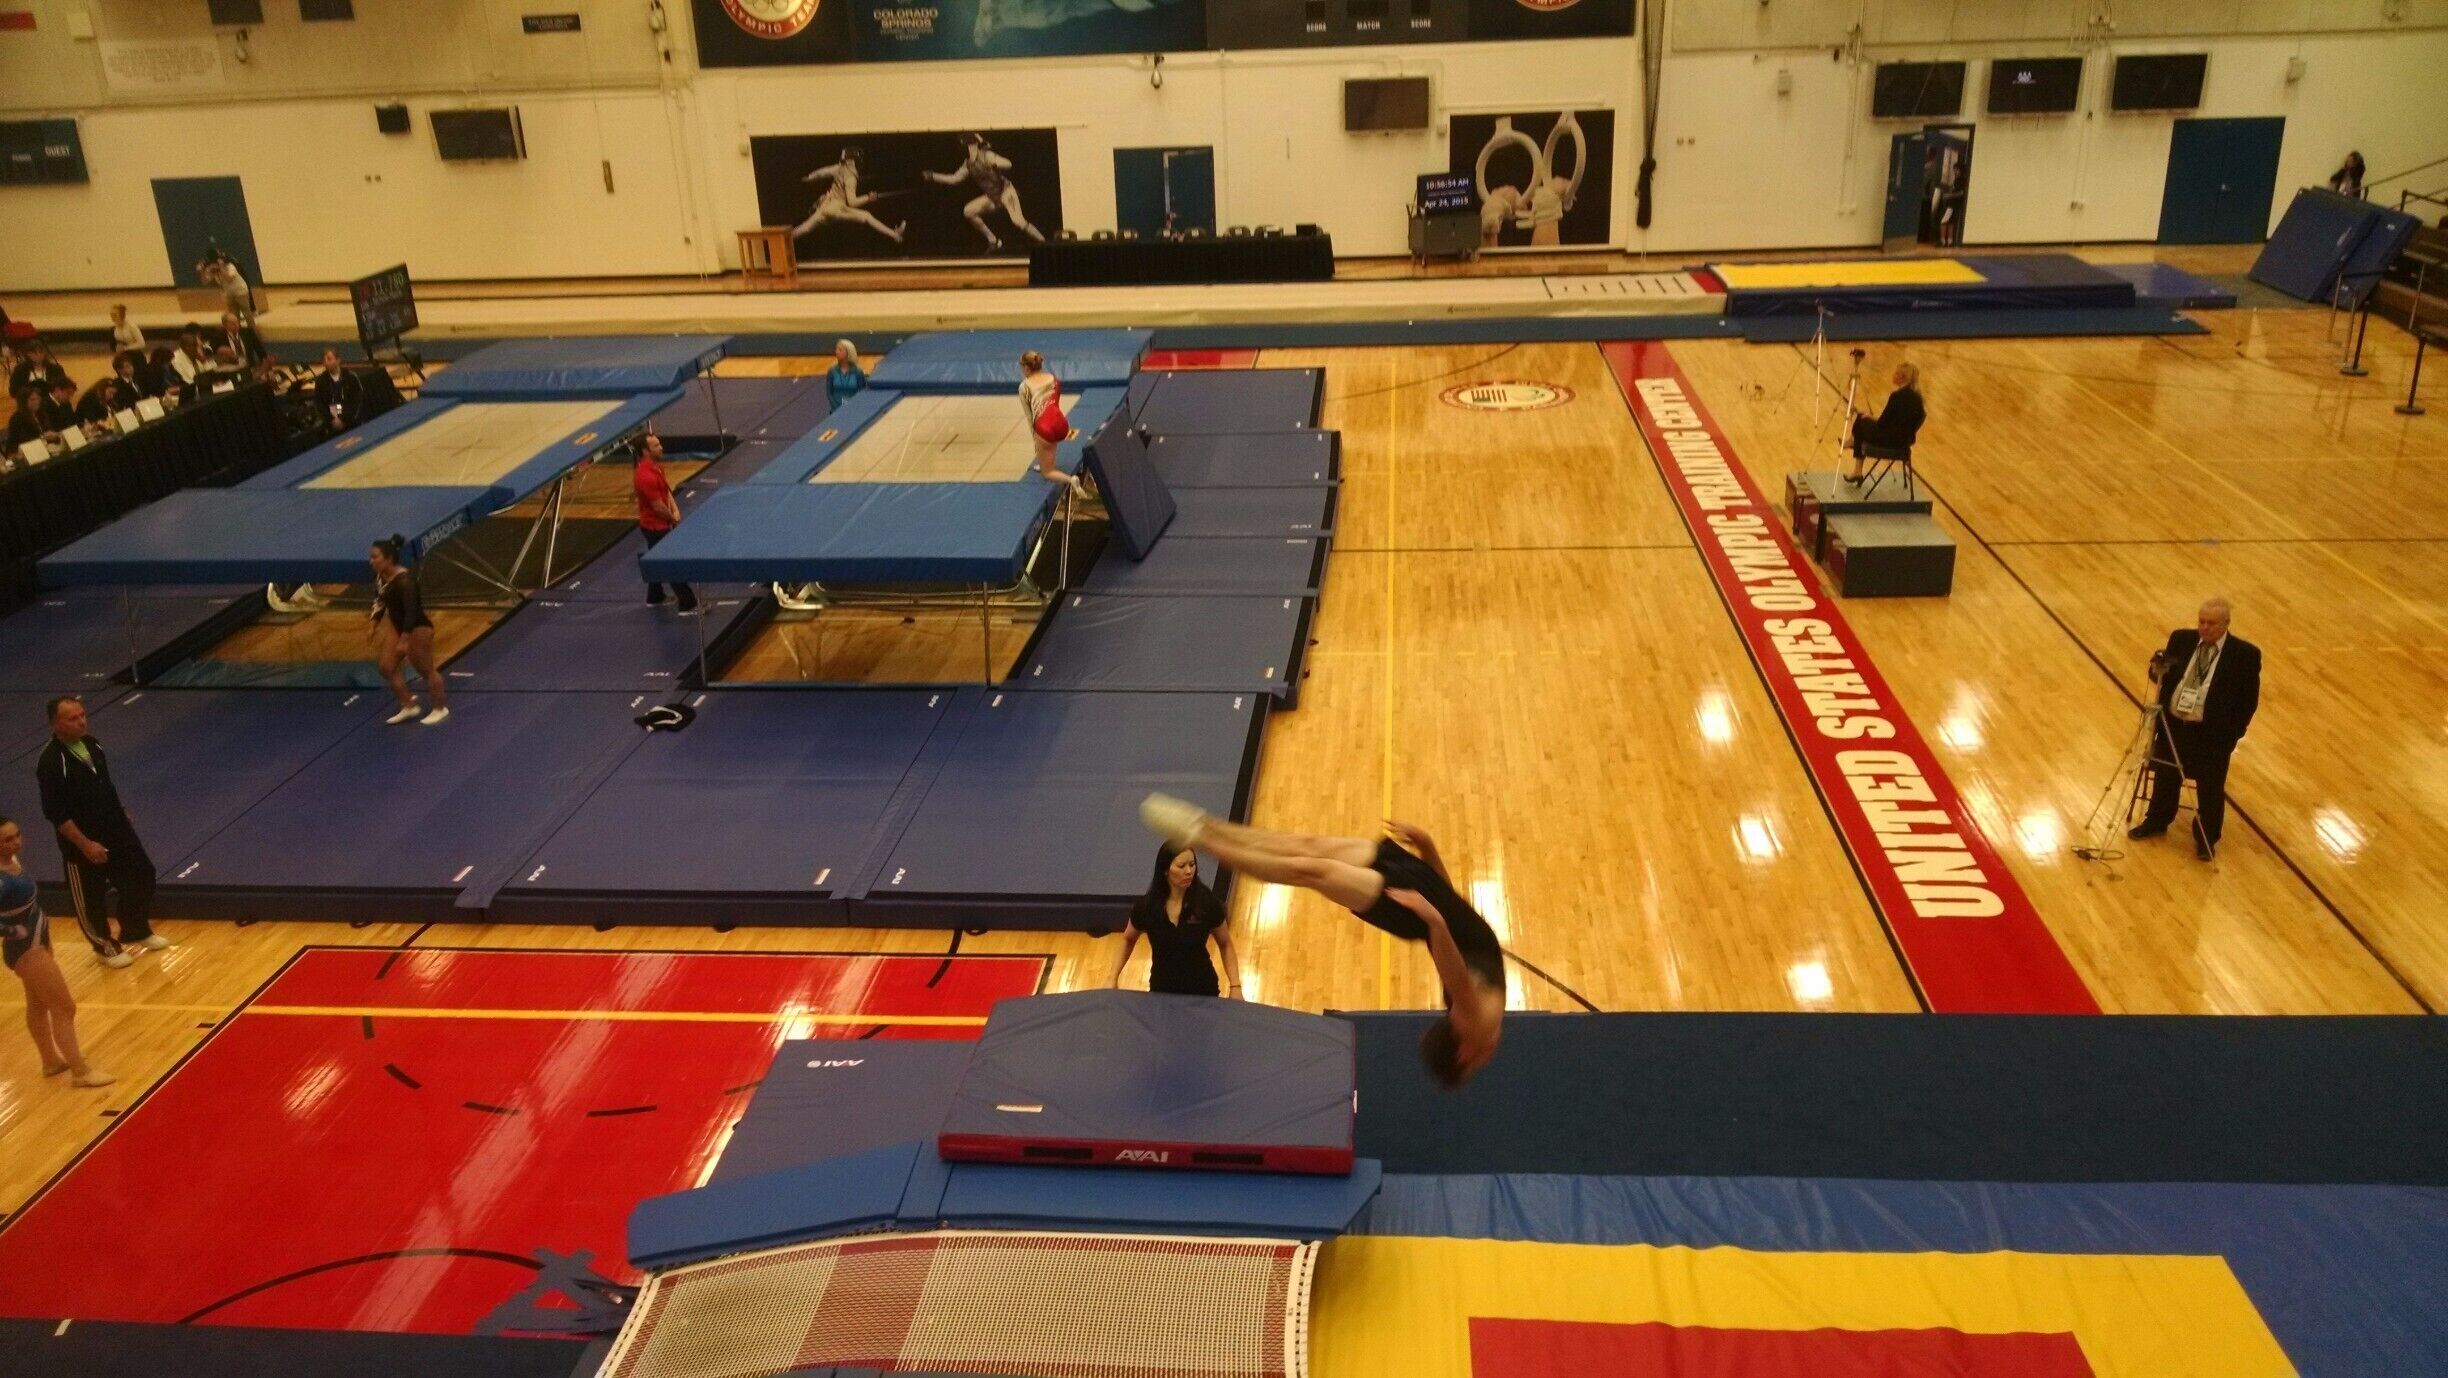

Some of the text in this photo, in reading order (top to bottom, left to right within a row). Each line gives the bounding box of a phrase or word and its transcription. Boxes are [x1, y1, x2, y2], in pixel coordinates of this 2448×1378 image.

[873, 8, 939, 20] COLORADO
[1356, 20, 1381, 30] MATCH
[1457, 177, 1469, 187] AM
[1425, 200, 1437, 209] Apr
[1634, 378, 2005, 918] UNITED STATES OLYMPIC TRAINING CENTER
